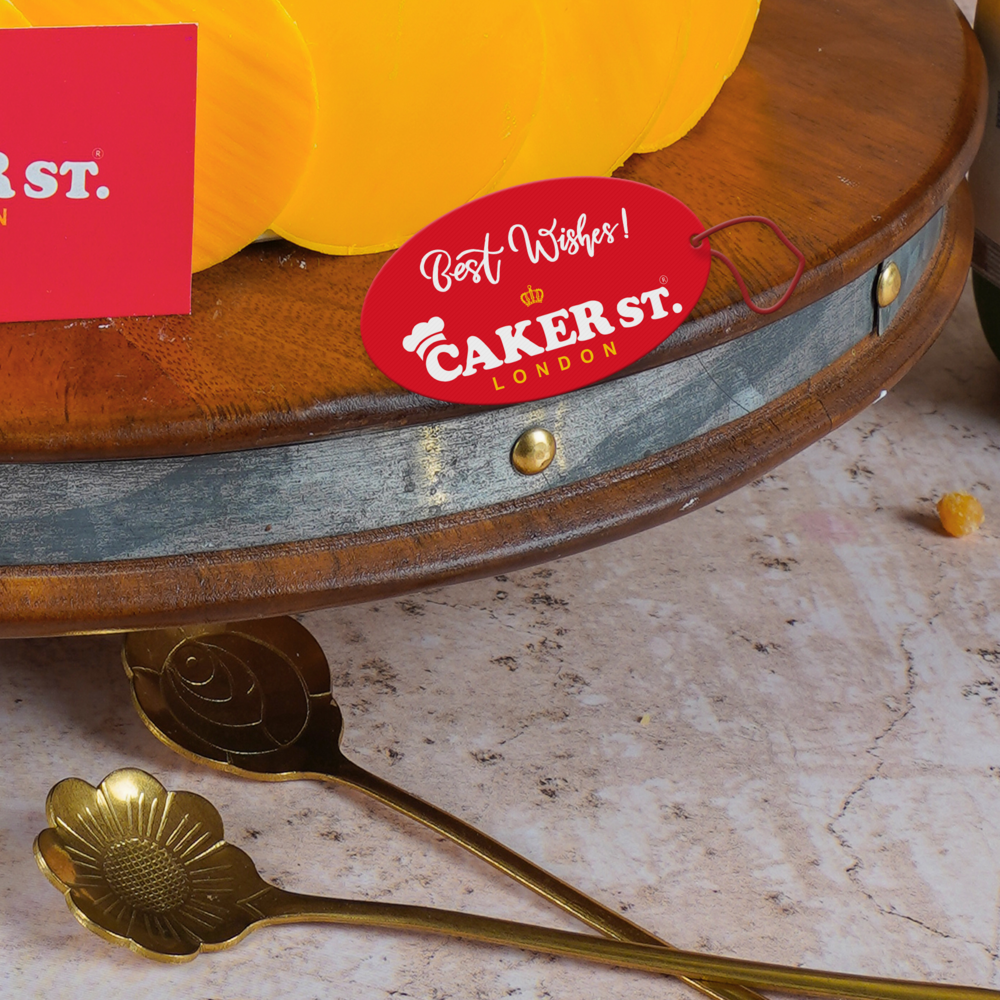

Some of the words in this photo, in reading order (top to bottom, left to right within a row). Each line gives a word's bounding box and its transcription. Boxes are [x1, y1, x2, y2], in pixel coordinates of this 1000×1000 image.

[23, 160, 110, 200] ST.
[419, 232, 504, 293] Best
[507, 207, 630, 264] Wishes!
[425, 300, 616, 383] CAKER
[616, 286, 684, 328] ST.
[492, 341, 618, 392] LONDON
